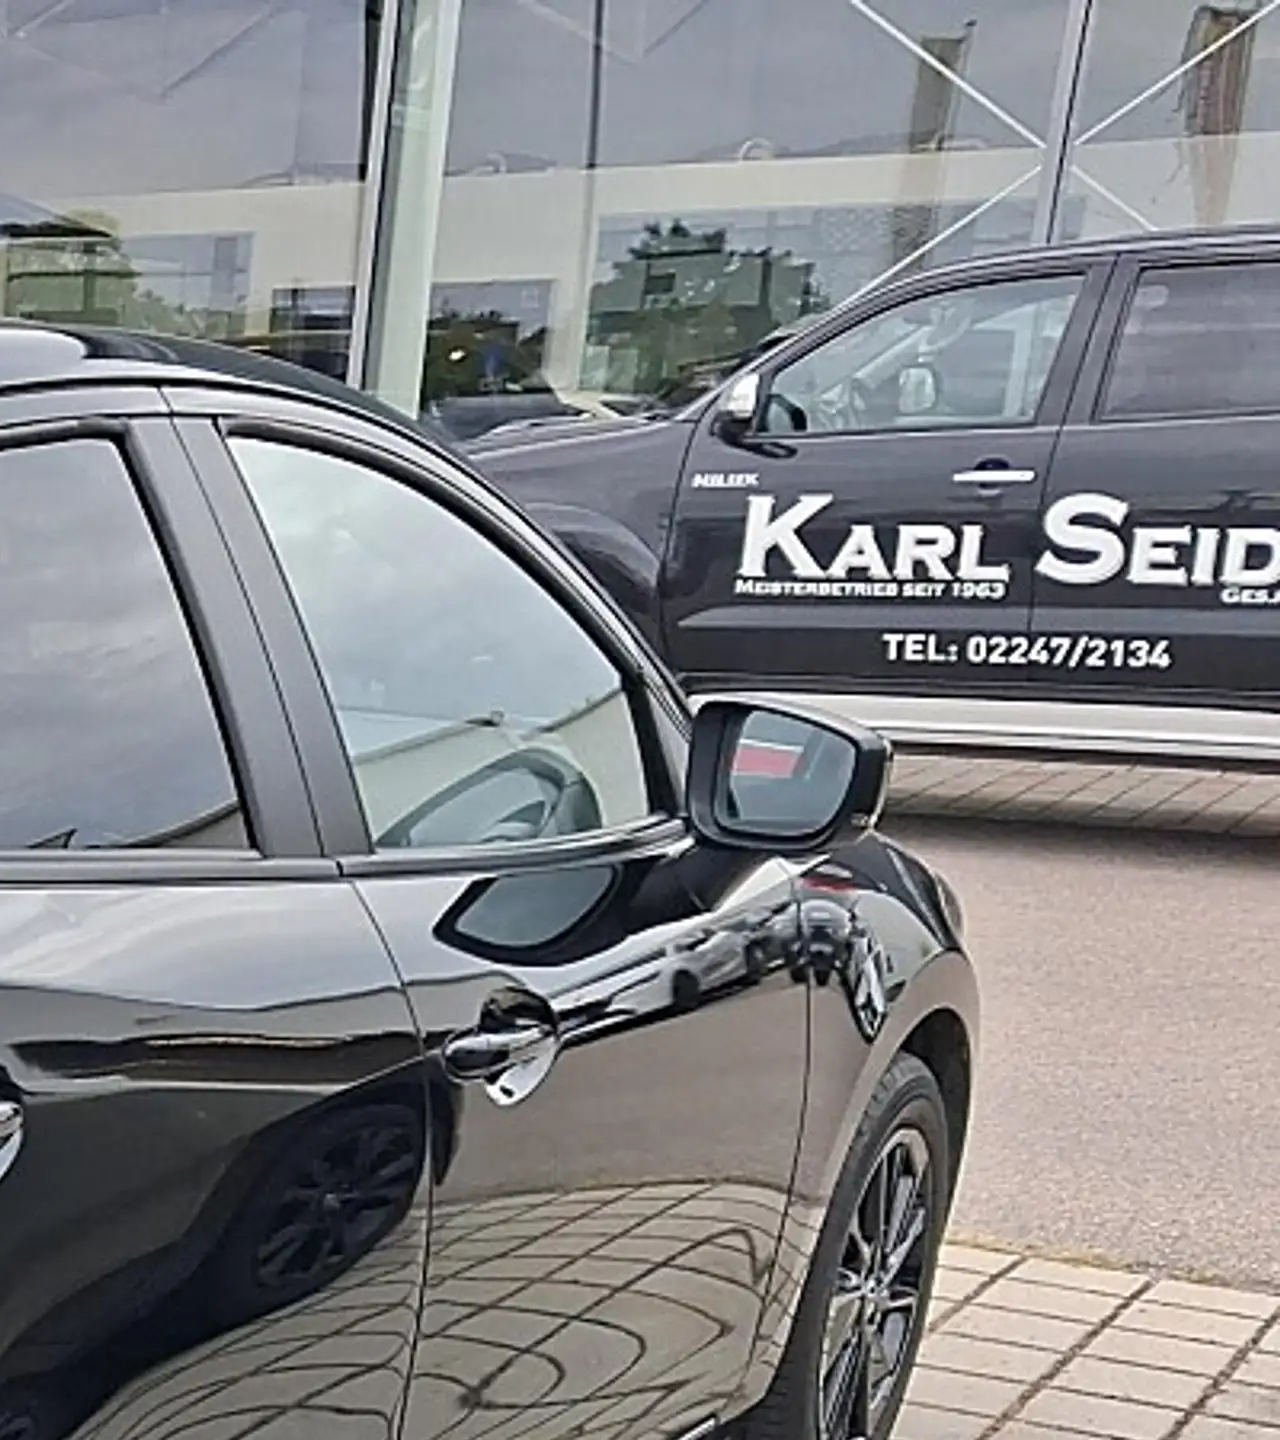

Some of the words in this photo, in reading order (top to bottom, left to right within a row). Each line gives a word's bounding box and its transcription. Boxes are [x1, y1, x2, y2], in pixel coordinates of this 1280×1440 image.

[951, 581, 1007, 599] 1963
[882, 632, 958, 662] TEL:
[965, 635, 1171, 669] 02247/2134
